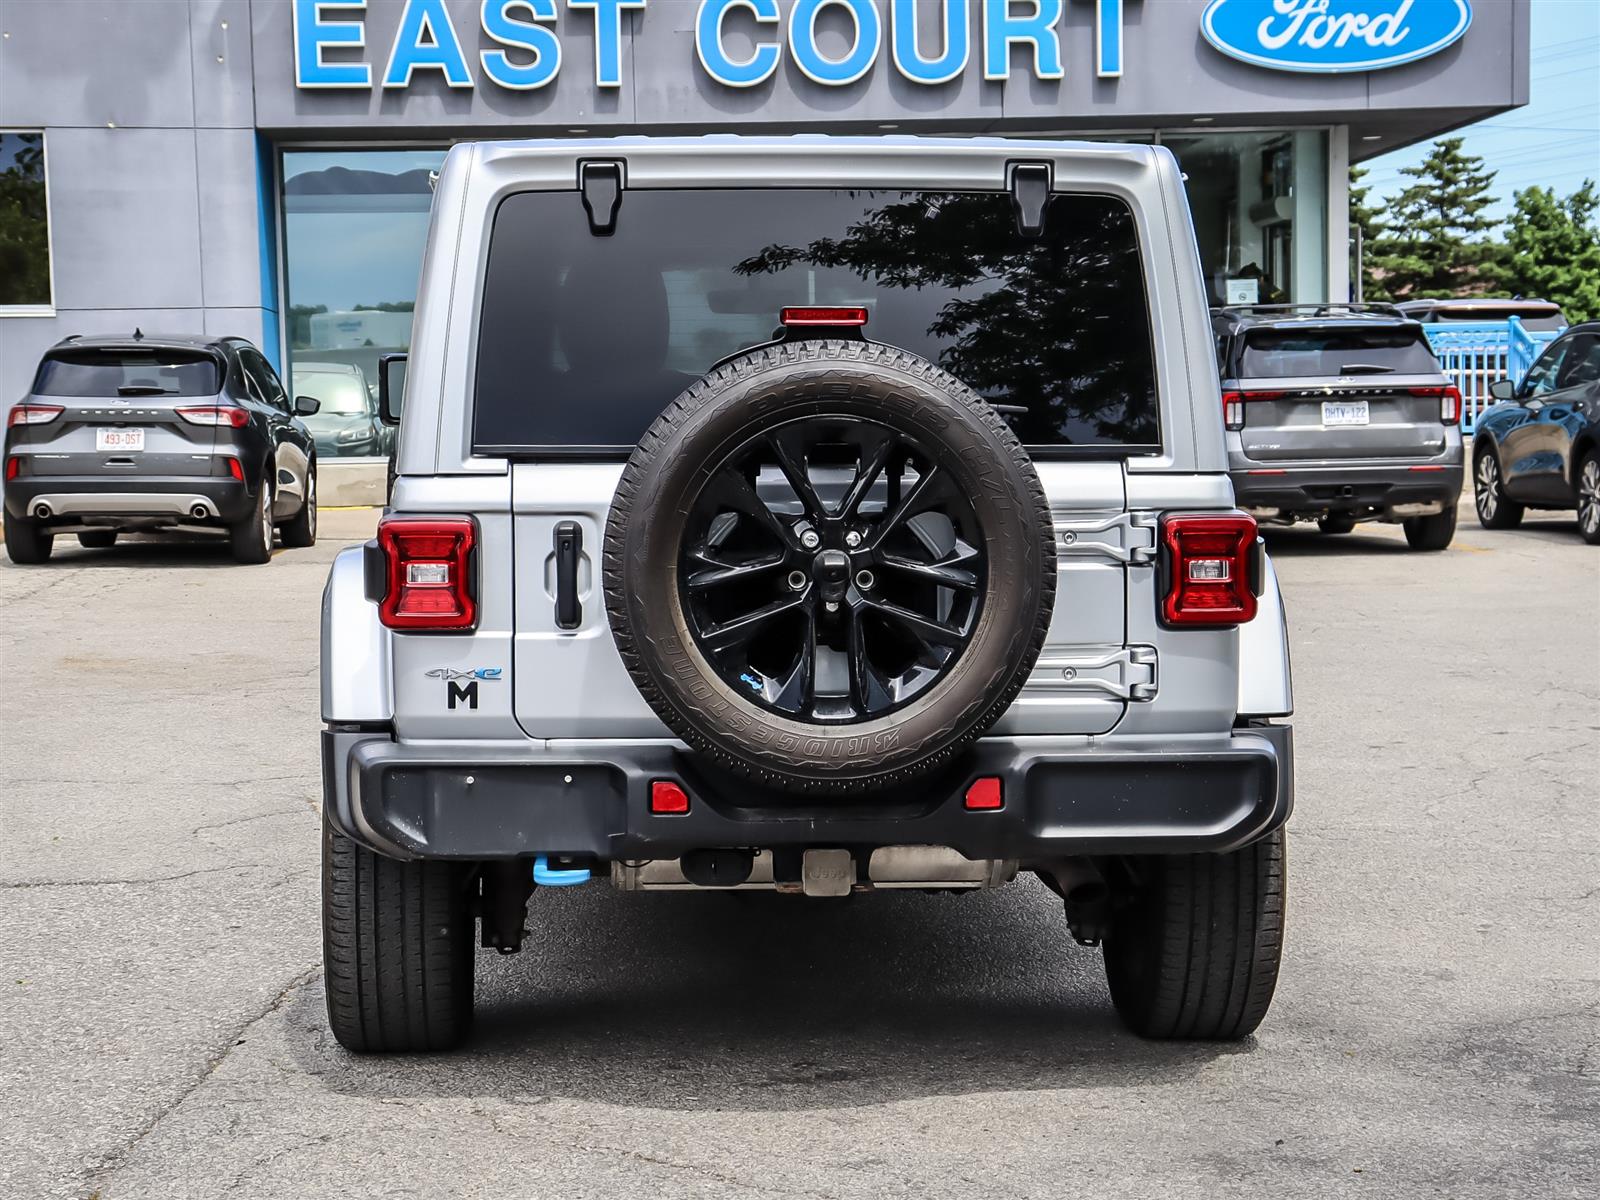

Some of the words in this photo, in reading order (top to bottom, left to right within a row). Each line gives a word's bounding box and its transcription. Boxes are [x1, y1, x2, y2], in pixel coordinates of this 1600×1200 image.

[293, 0, 646, 90] EAST
[1257, 0, 1410, 49] Ford
[447, 681, 478, 709] M
[660, 635, 901, 757] BRIDGESTONE
